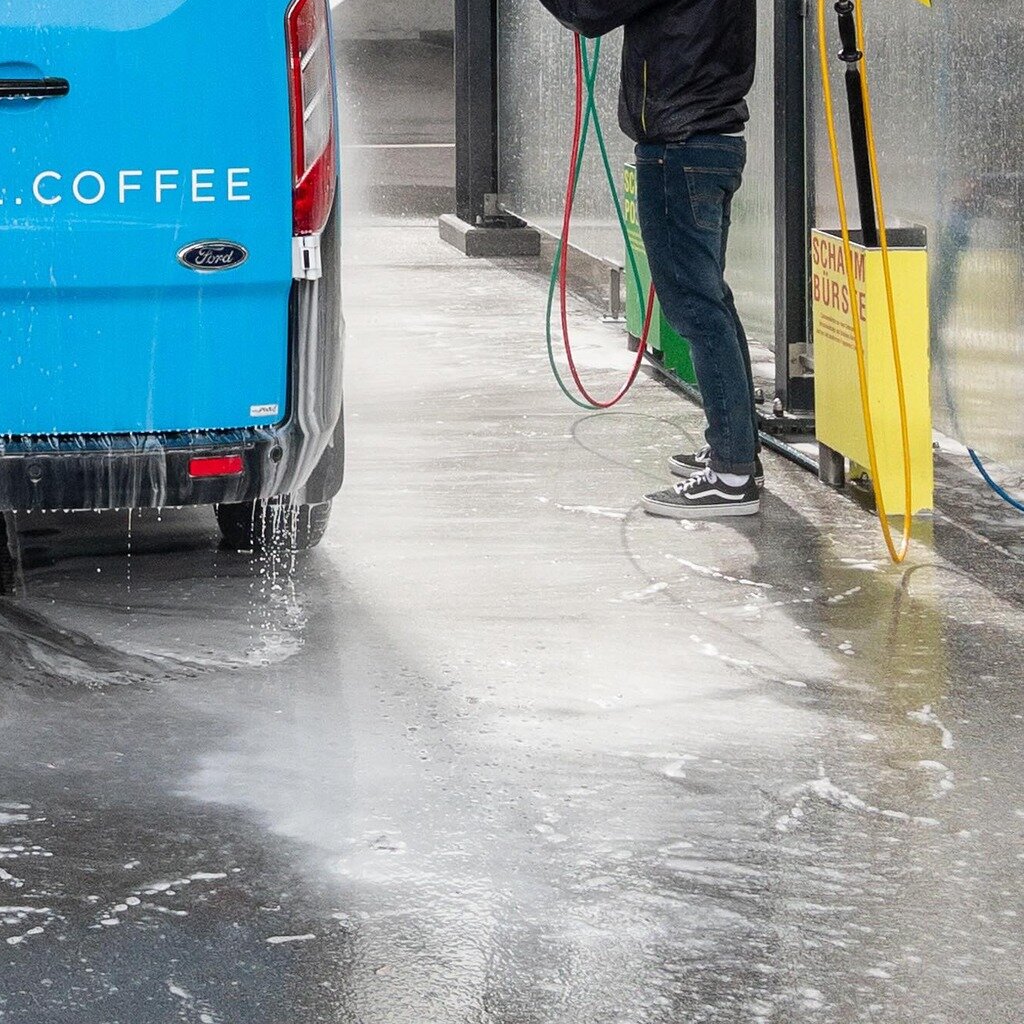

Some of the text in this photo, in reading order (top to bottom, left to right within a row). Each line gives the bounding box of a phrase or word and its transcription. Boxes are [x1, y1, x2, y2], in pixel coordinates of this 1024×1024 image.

[195, 245, 235, 265] Ford
[813, 237, 866, 283] SCHAM
[813, 270, 867, 322] BÜRSE
